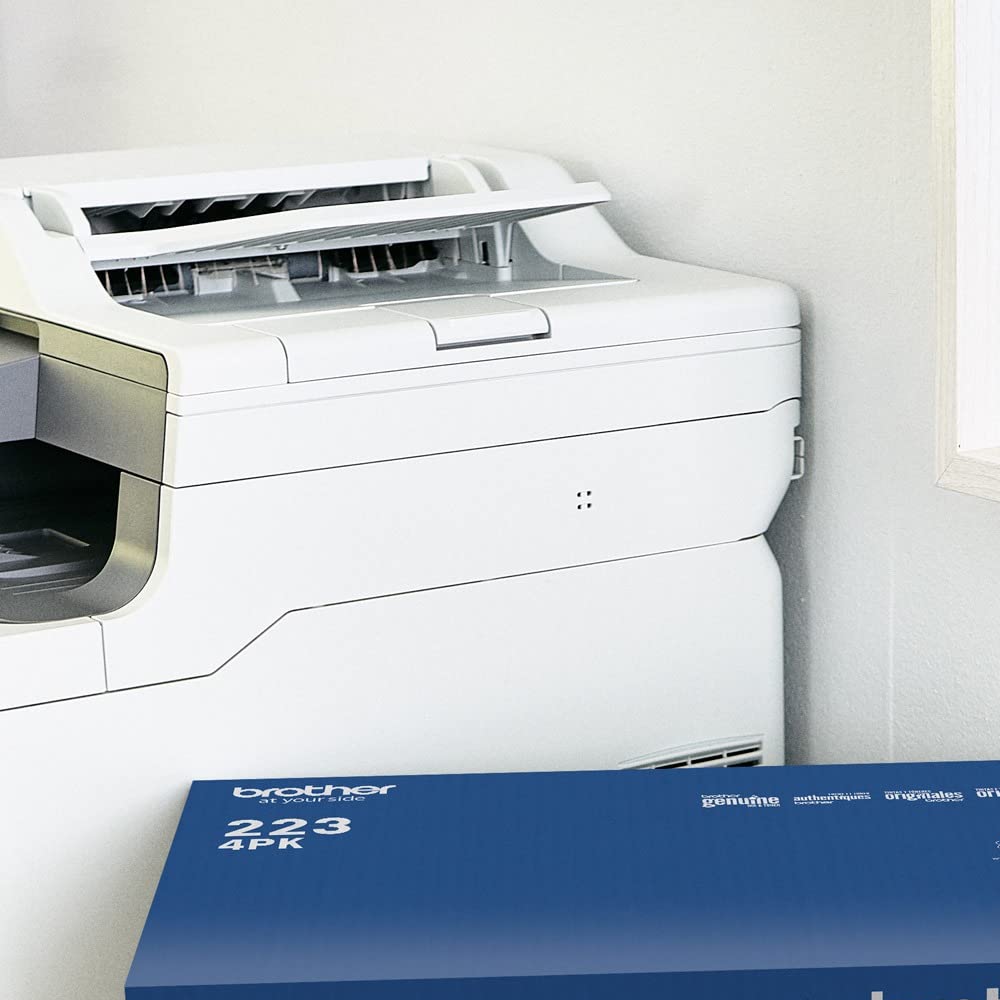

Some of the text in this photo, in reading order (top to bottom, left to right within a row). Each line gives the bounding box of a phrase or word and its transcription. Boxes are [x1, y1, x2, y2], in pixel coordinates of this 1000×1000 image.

[232, 784, 397, 798] brother
[885, 790, 964, 802] originales
[282, 796, 326, 805] your
[328, 795, 366, 803] side
[701, 795, 780, 808] genuine
[224, 816, 352, 837] 223
[218, 837, 305, 850] 4PK
